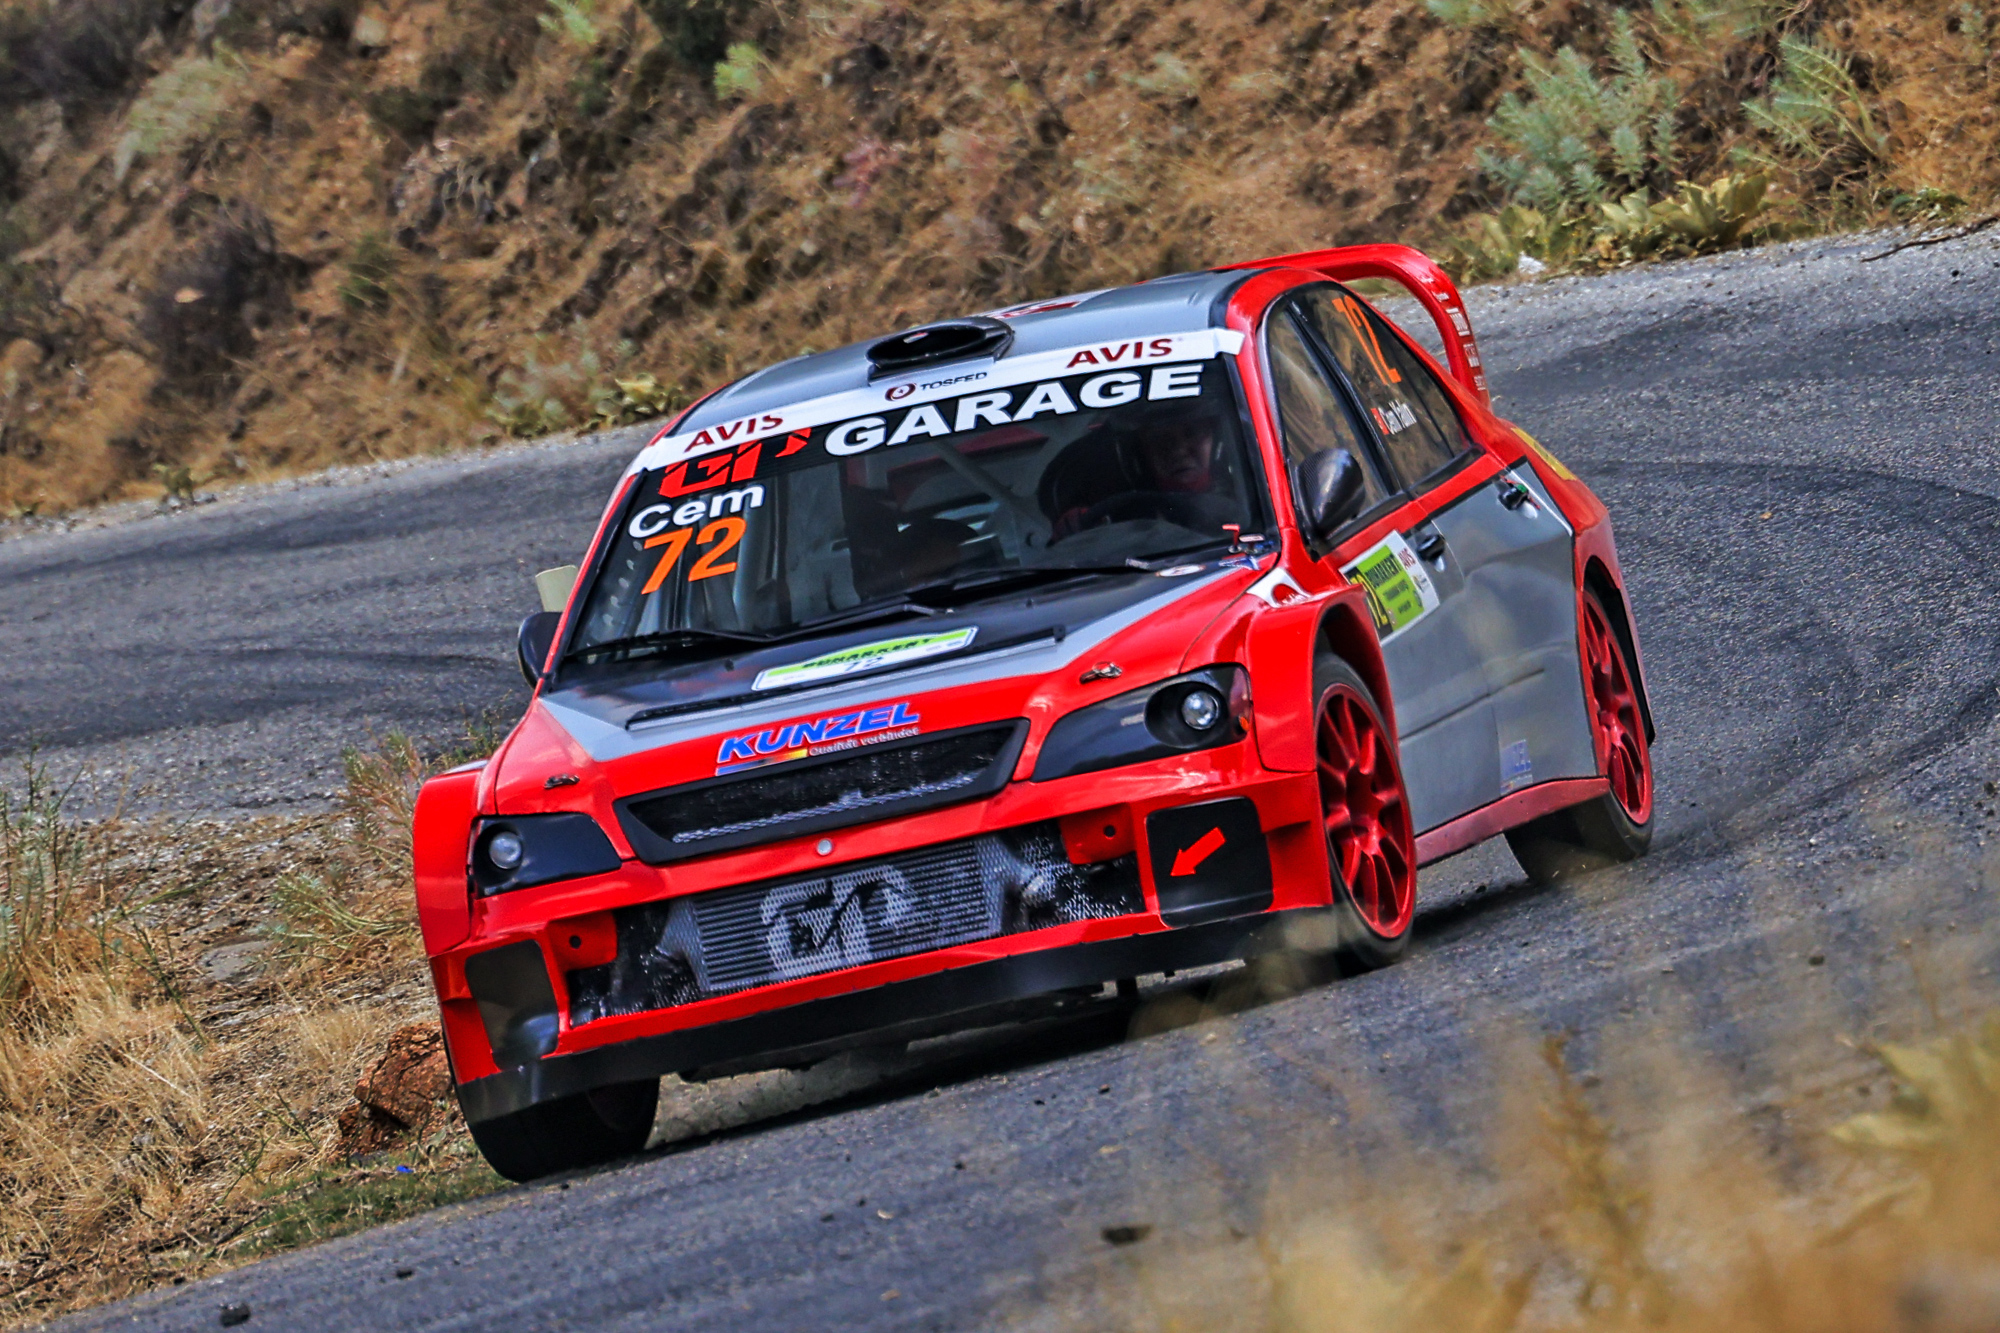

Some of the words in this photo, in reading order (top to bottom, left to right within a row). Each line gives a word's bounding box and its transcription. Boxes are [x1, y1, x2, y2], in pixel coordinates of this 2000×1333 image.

[1065, 338, 1174, 369] AVIS
[1332, 294, 1401, 385] 72
[920, 371, 988, 391] TOSFED
[683, 415, 784, 453] AVIS
[824, 363, 1205, 457] GARAGE
[628, 483, 766, 538] Cem
[641, 516, 747, 595] 72
[844, 656, 885, 672] 72
[716, 702, 920, 763] KUNZEL
